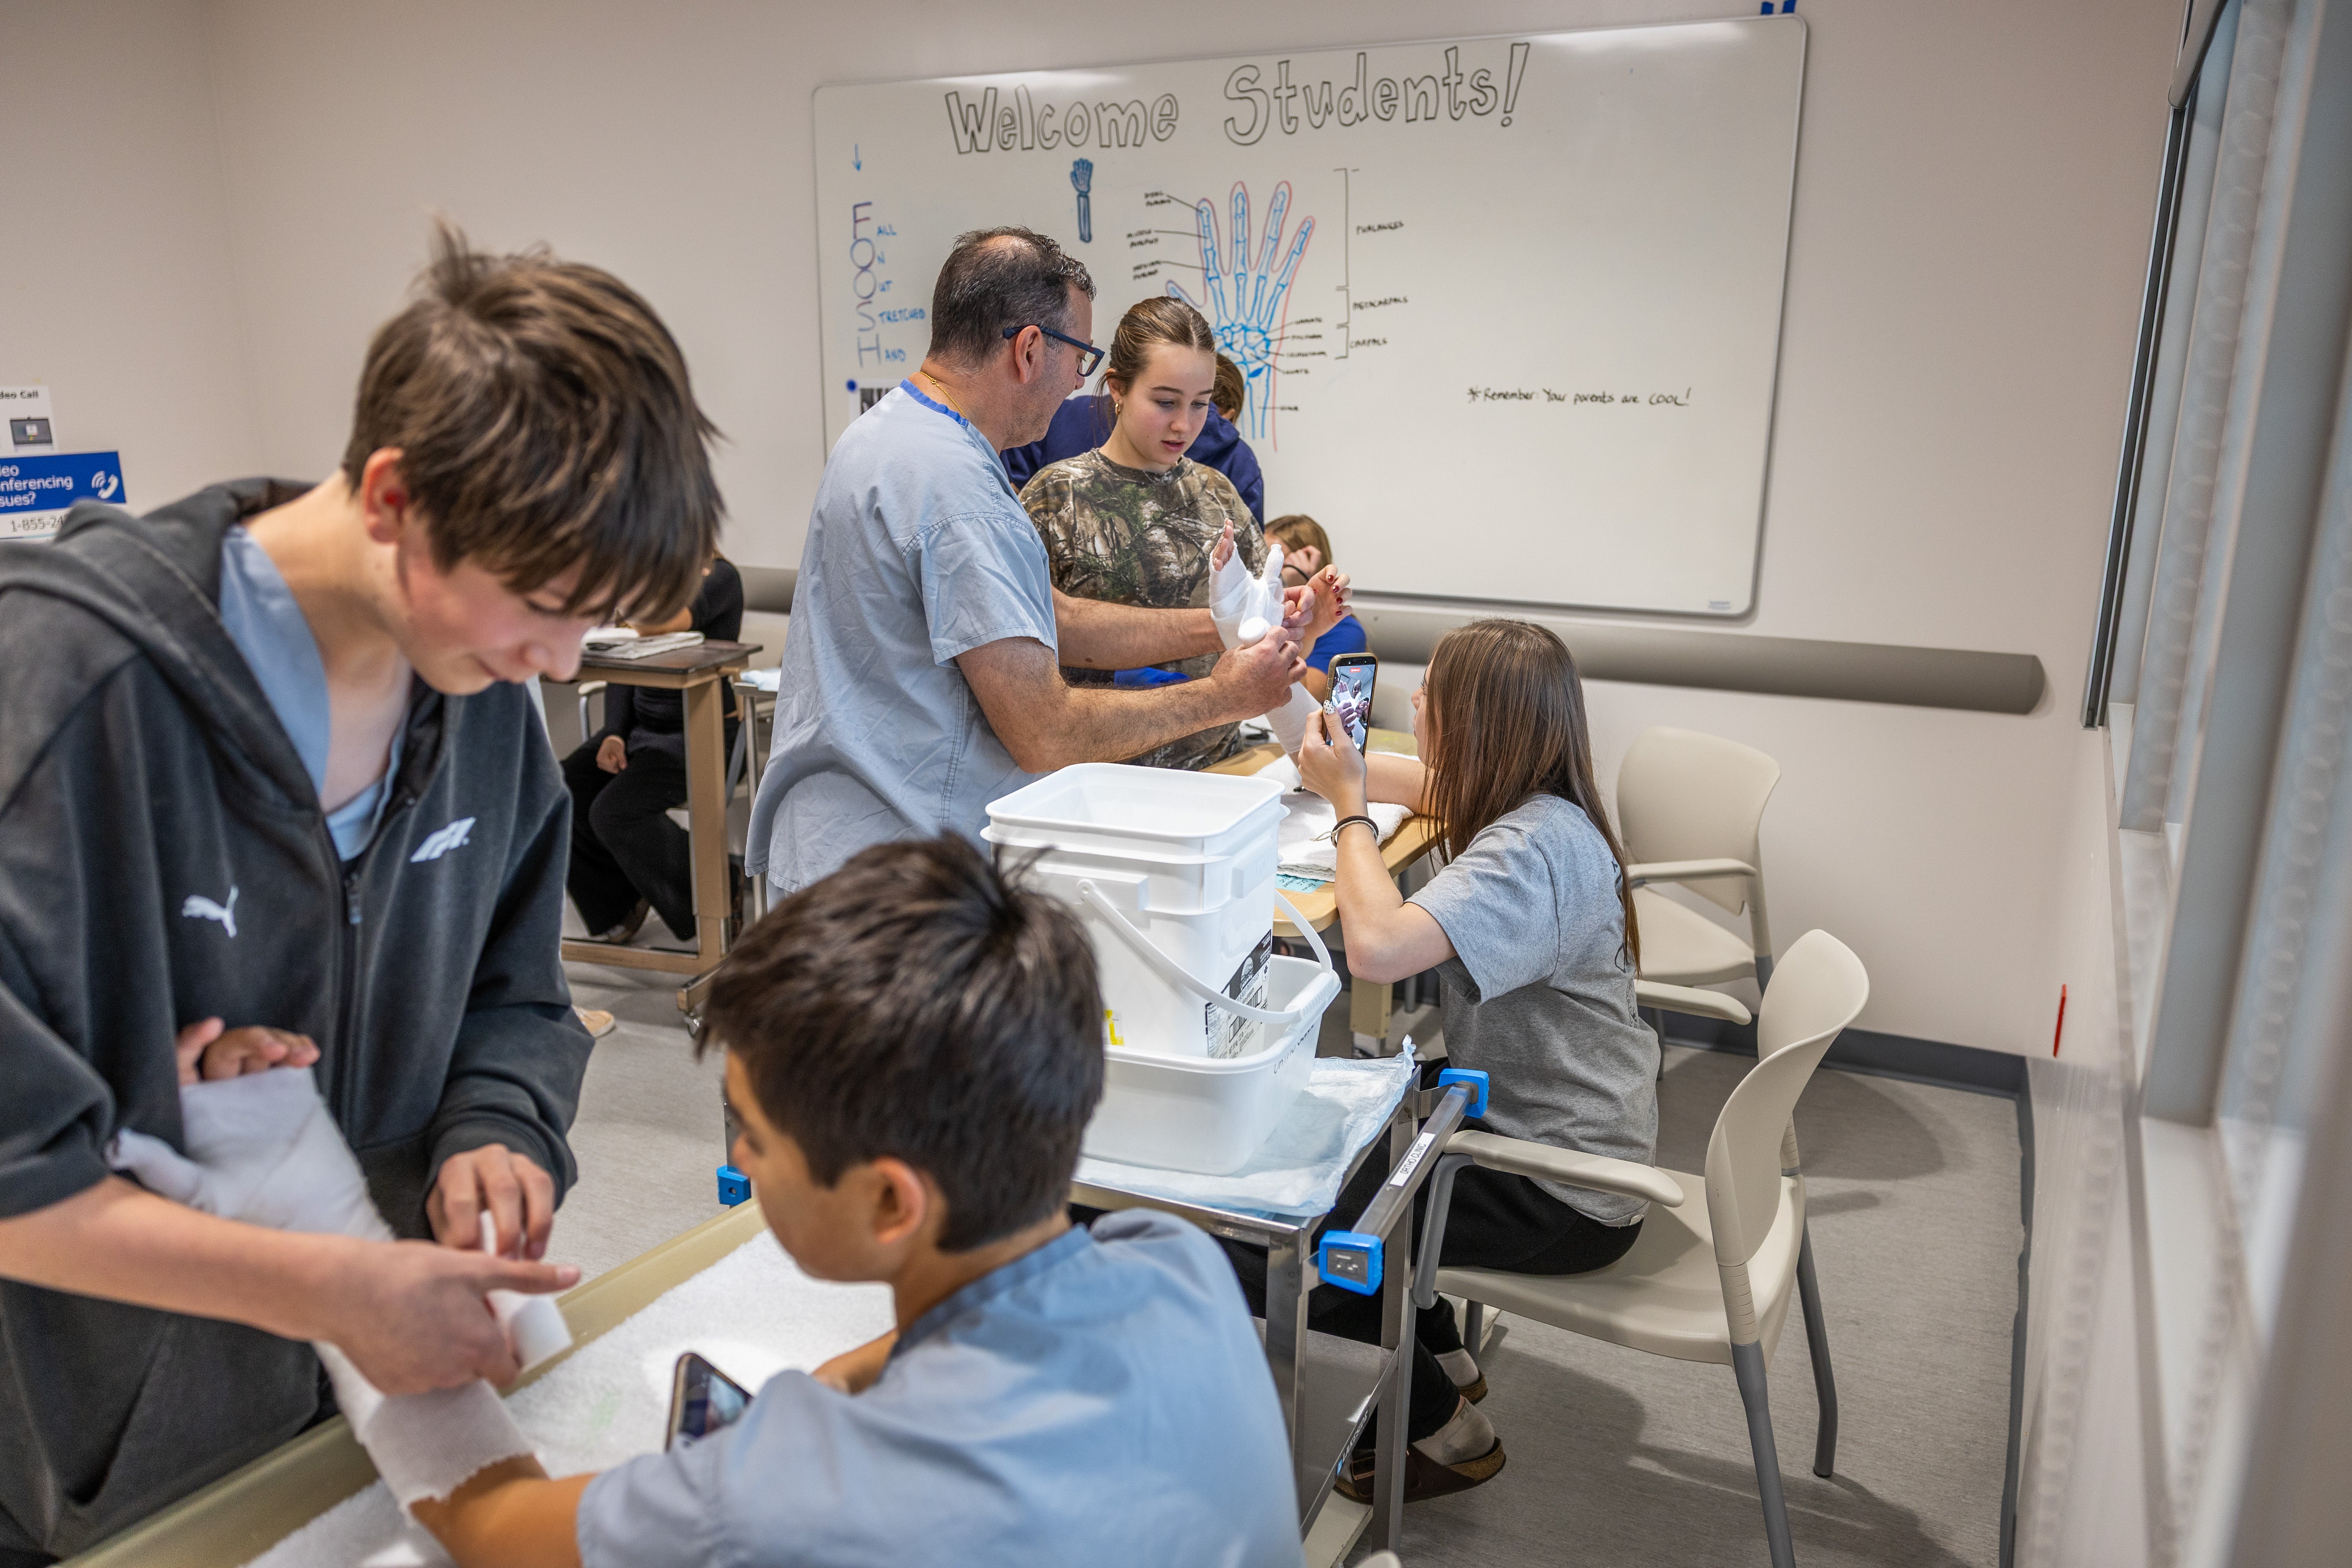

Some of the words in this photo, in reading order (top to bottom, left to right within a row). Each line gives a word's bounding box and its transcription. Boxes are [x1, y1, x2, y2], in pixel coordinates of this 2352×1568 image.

[944, 87, 1179, 155] Welcome
[1223, 42, 1531, 147] Students!
[20, 389, 39, 399] Call
[1573, 391, 1615, 405] parents
[1621, 394, 1640, 404] are
[1648, 387, 1691, 407] COOL!
[0, 465, 20, 477] eo
[11, 514, 67, 532] 1-855-24
[1400, 1158, 1417, 1175] ORTHO
[1411, 1143, 1426, 1158] CLINIC
[1343, 1410, 1368, 1463] LAKESIDE
